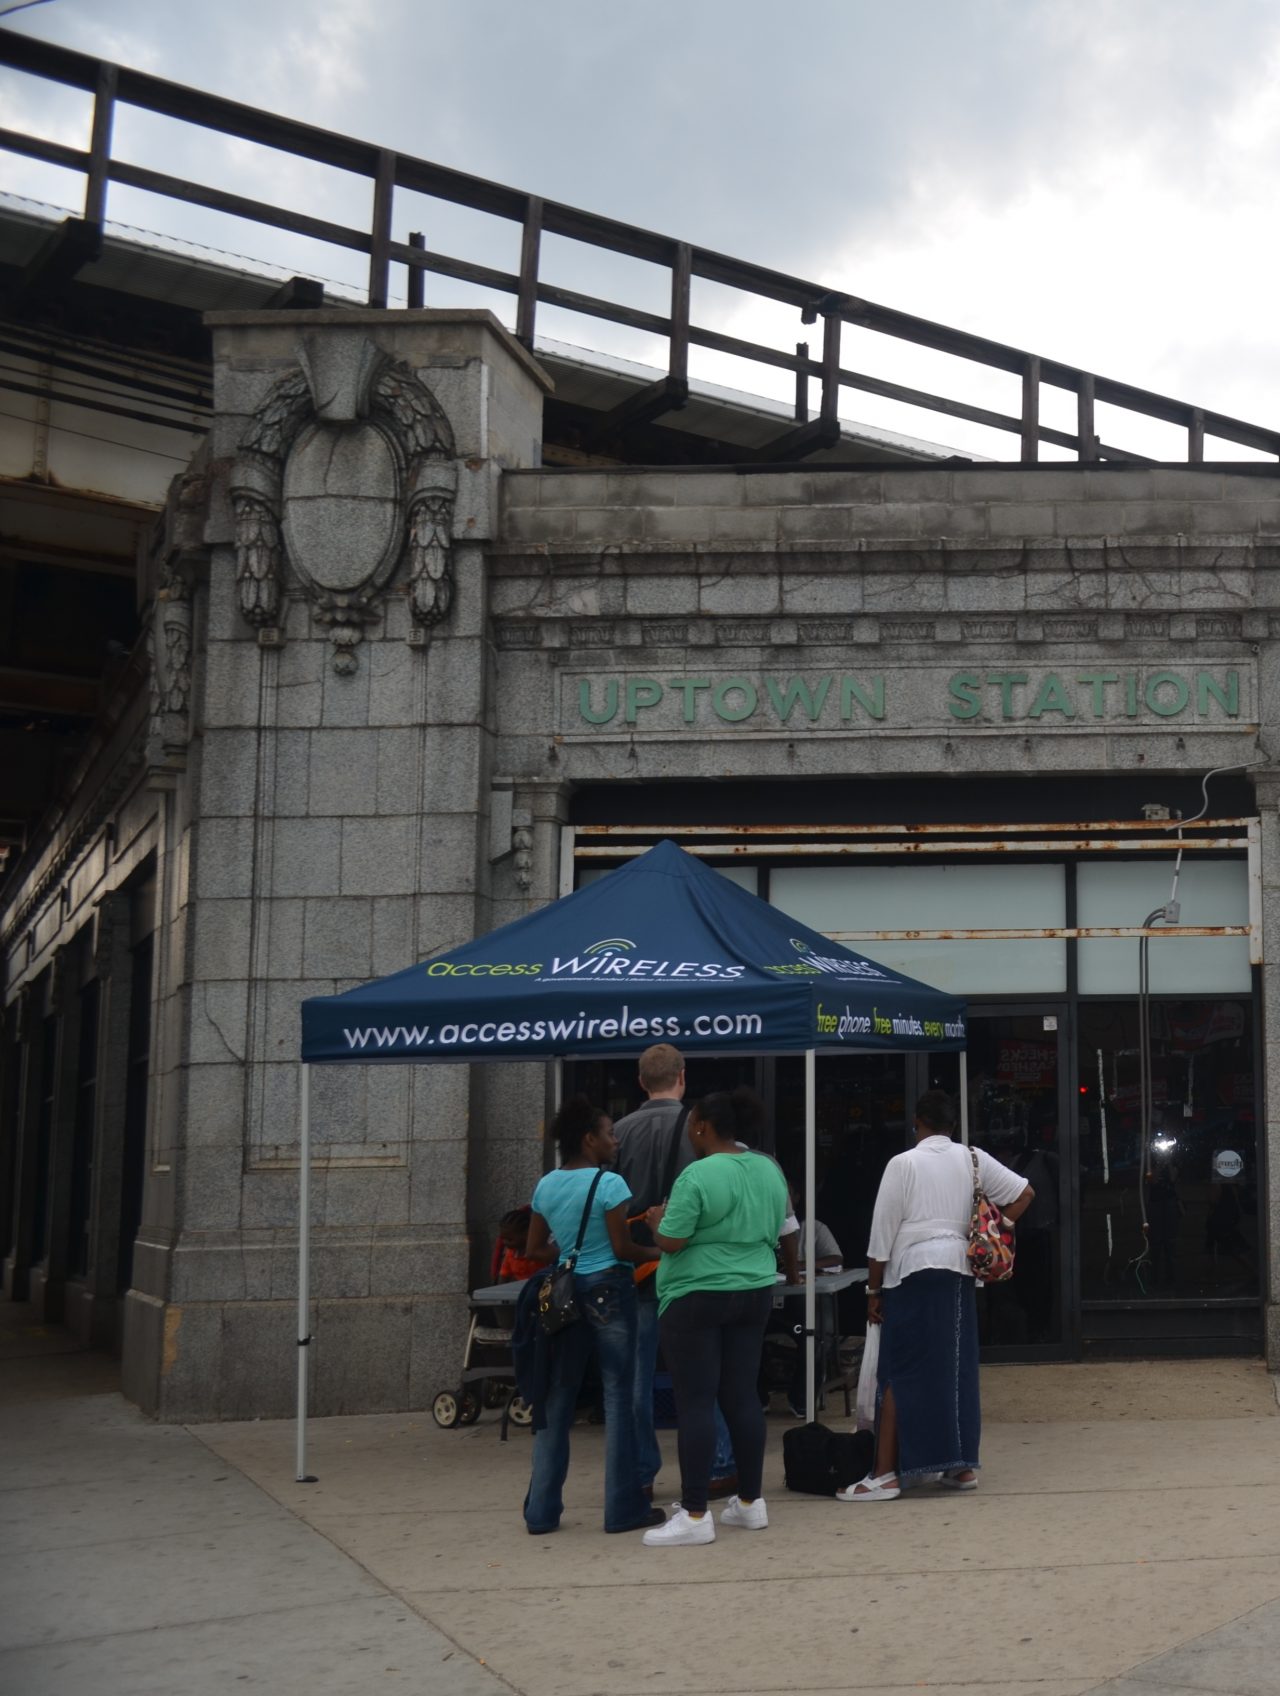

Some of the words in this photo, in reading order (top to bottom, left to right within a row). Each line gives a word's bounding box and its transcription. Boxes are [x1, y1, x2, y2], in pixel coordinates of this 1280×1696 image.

[578, 675, 885, 724] UPTOWN
[947, 671, 1239, 719] STATION
[427, 960, 543, 977] access
[343, 1007, 763, 1050] www.accesswireless.com
[816, 1003, 838, 1033] free
[838, 1005, 871, 1040] phone.
[873, 1007, 892, 1035] free
[892, 1013, 925, 1037] minutes.
[924, 1020, 945, 1040] every
